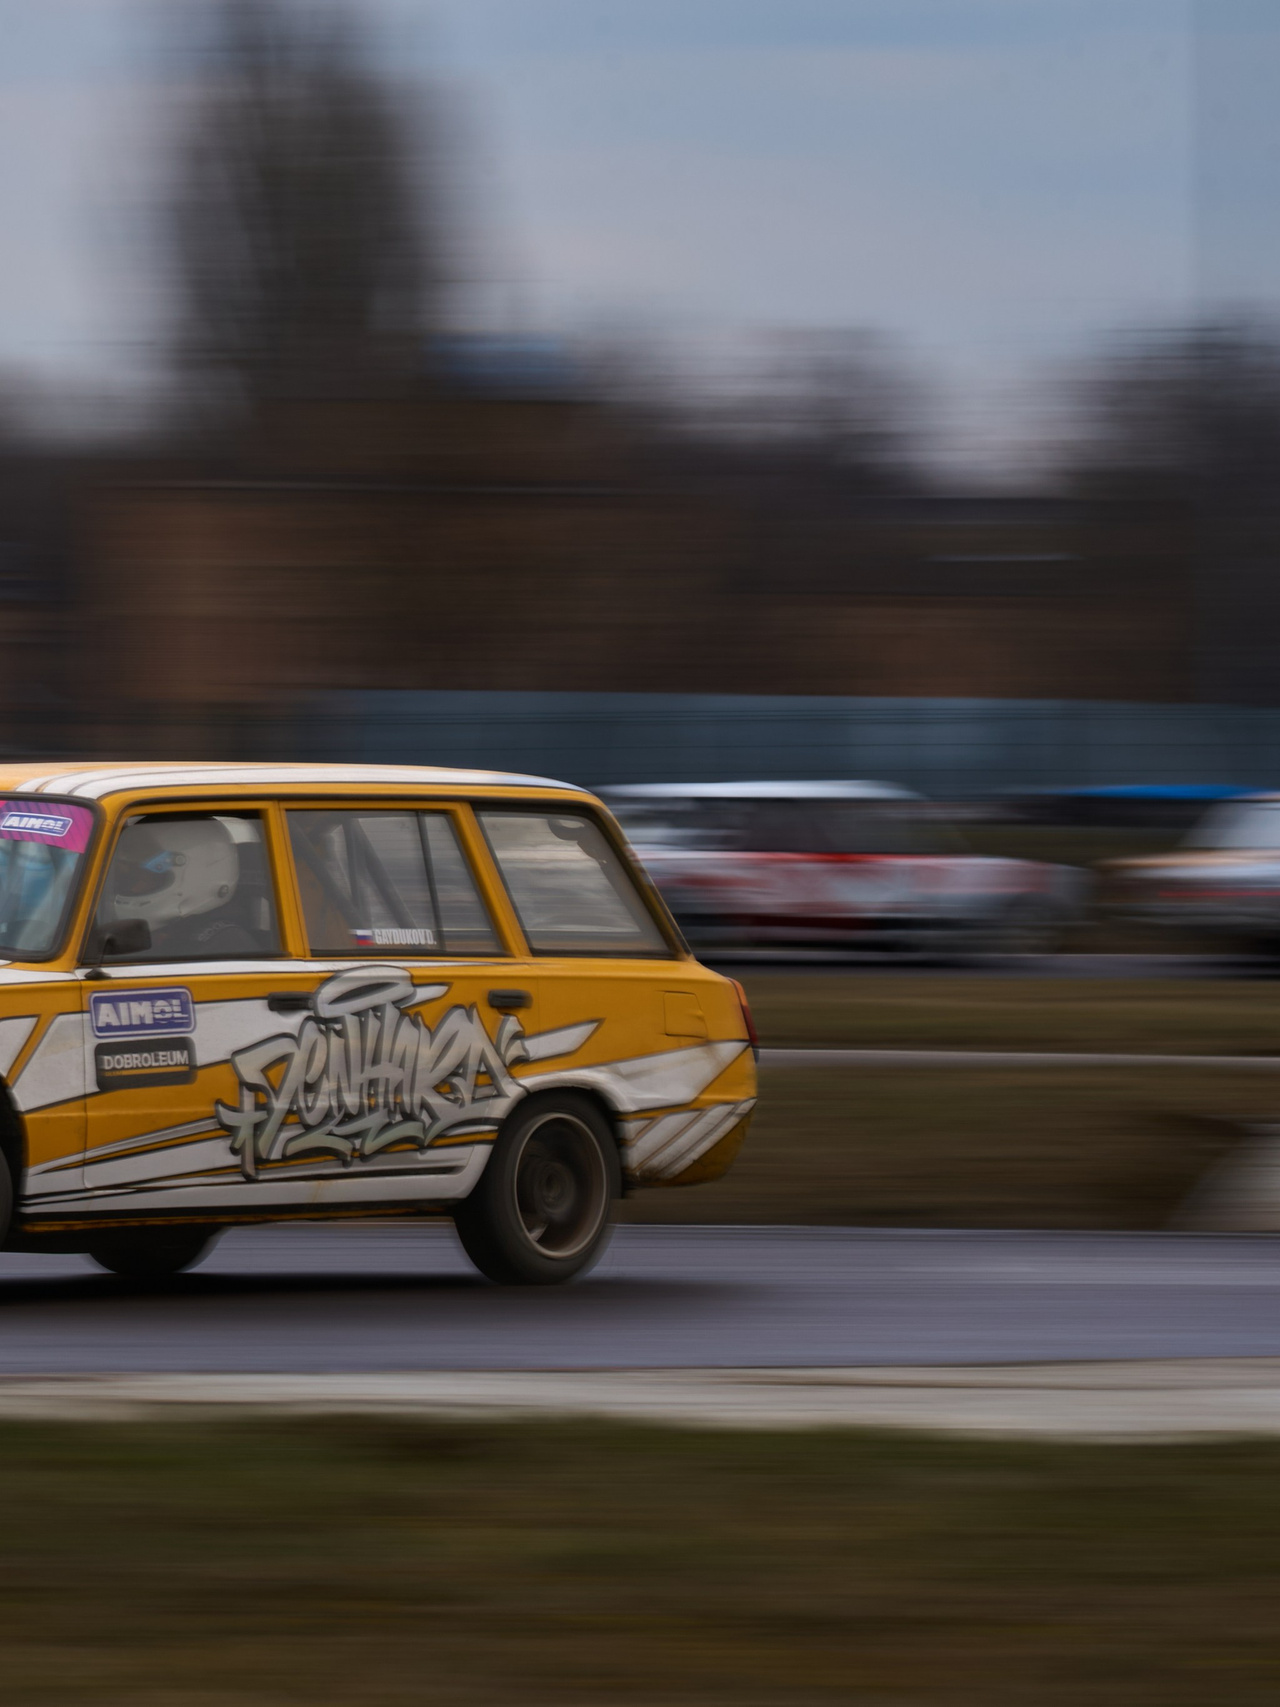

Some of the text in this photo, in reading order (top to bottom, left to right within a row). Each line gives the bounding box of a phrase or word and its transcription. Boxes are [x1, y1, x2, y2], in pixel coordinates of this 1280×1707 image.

[4, 816, 65, 832] AIMOL
[96, 999, 190, 1027] AIMOL
[103, 1050, 190, 1070] DOBROLEUM
